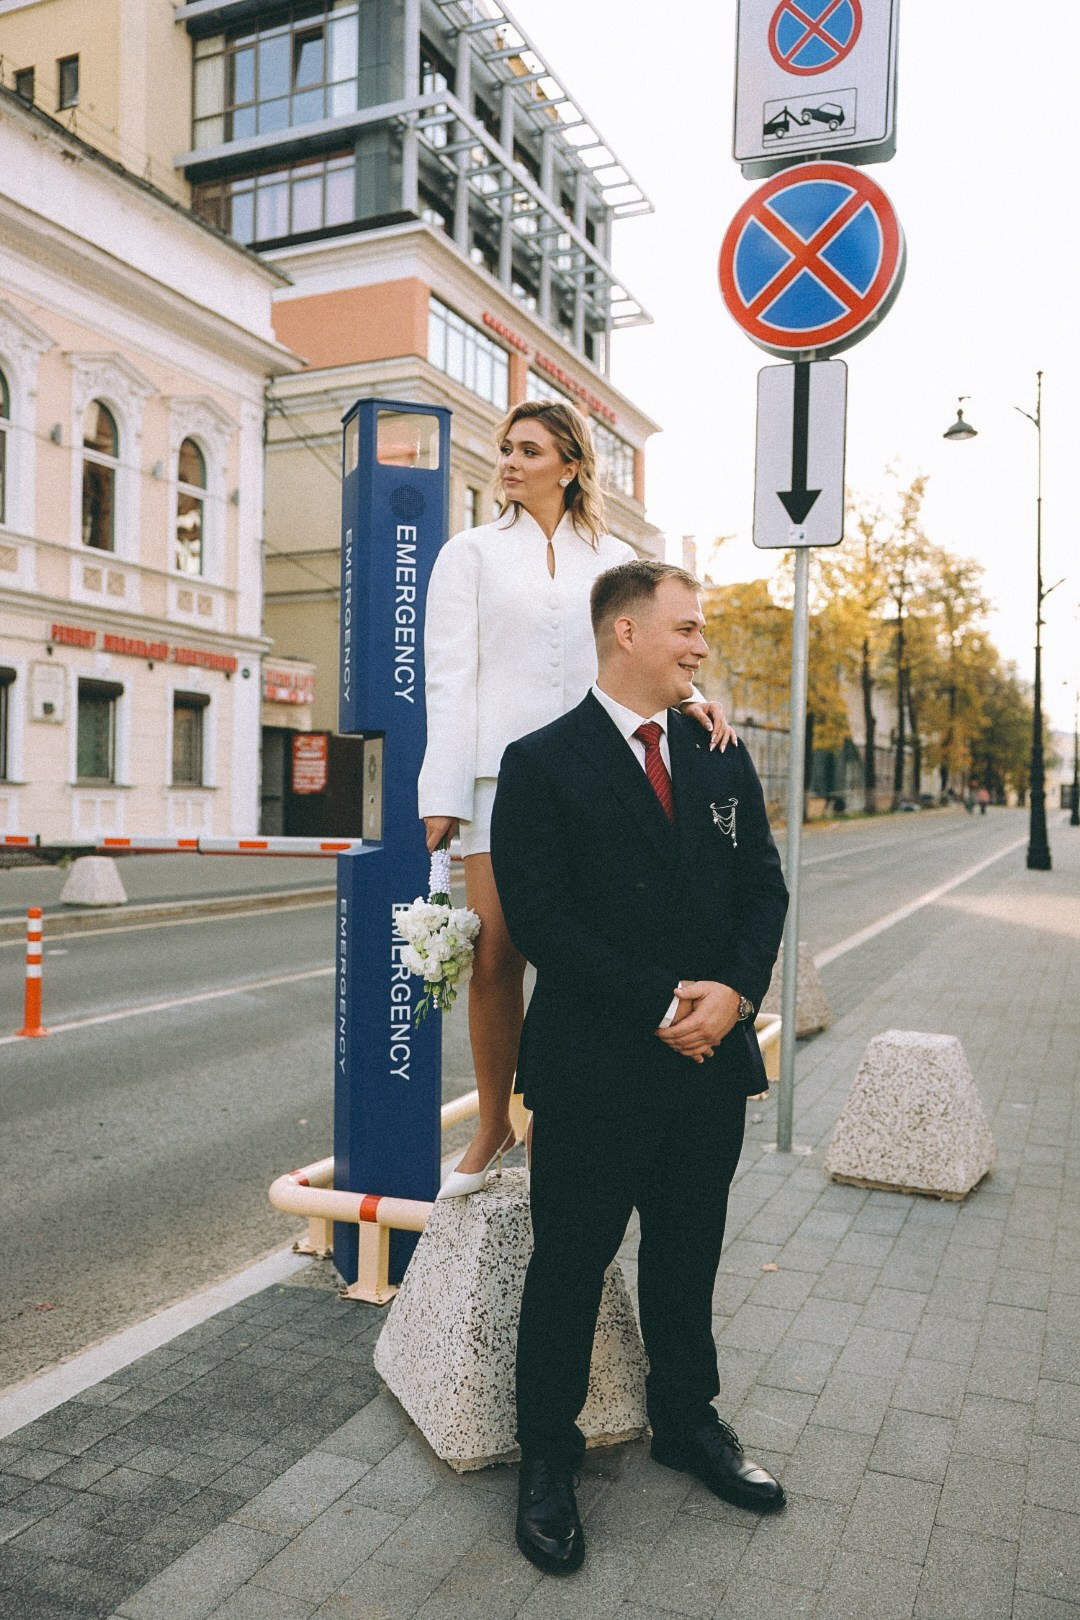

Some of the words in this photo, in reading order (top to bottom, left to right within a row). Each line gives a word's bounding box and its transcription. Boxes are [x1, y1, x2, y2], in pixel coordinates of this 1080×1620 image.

[343, 528, 353, 702] EMERGENCY
[394, 525, 417, 704] EMERGENCY
[338, 899, 348, 1074] EMERGENCY
